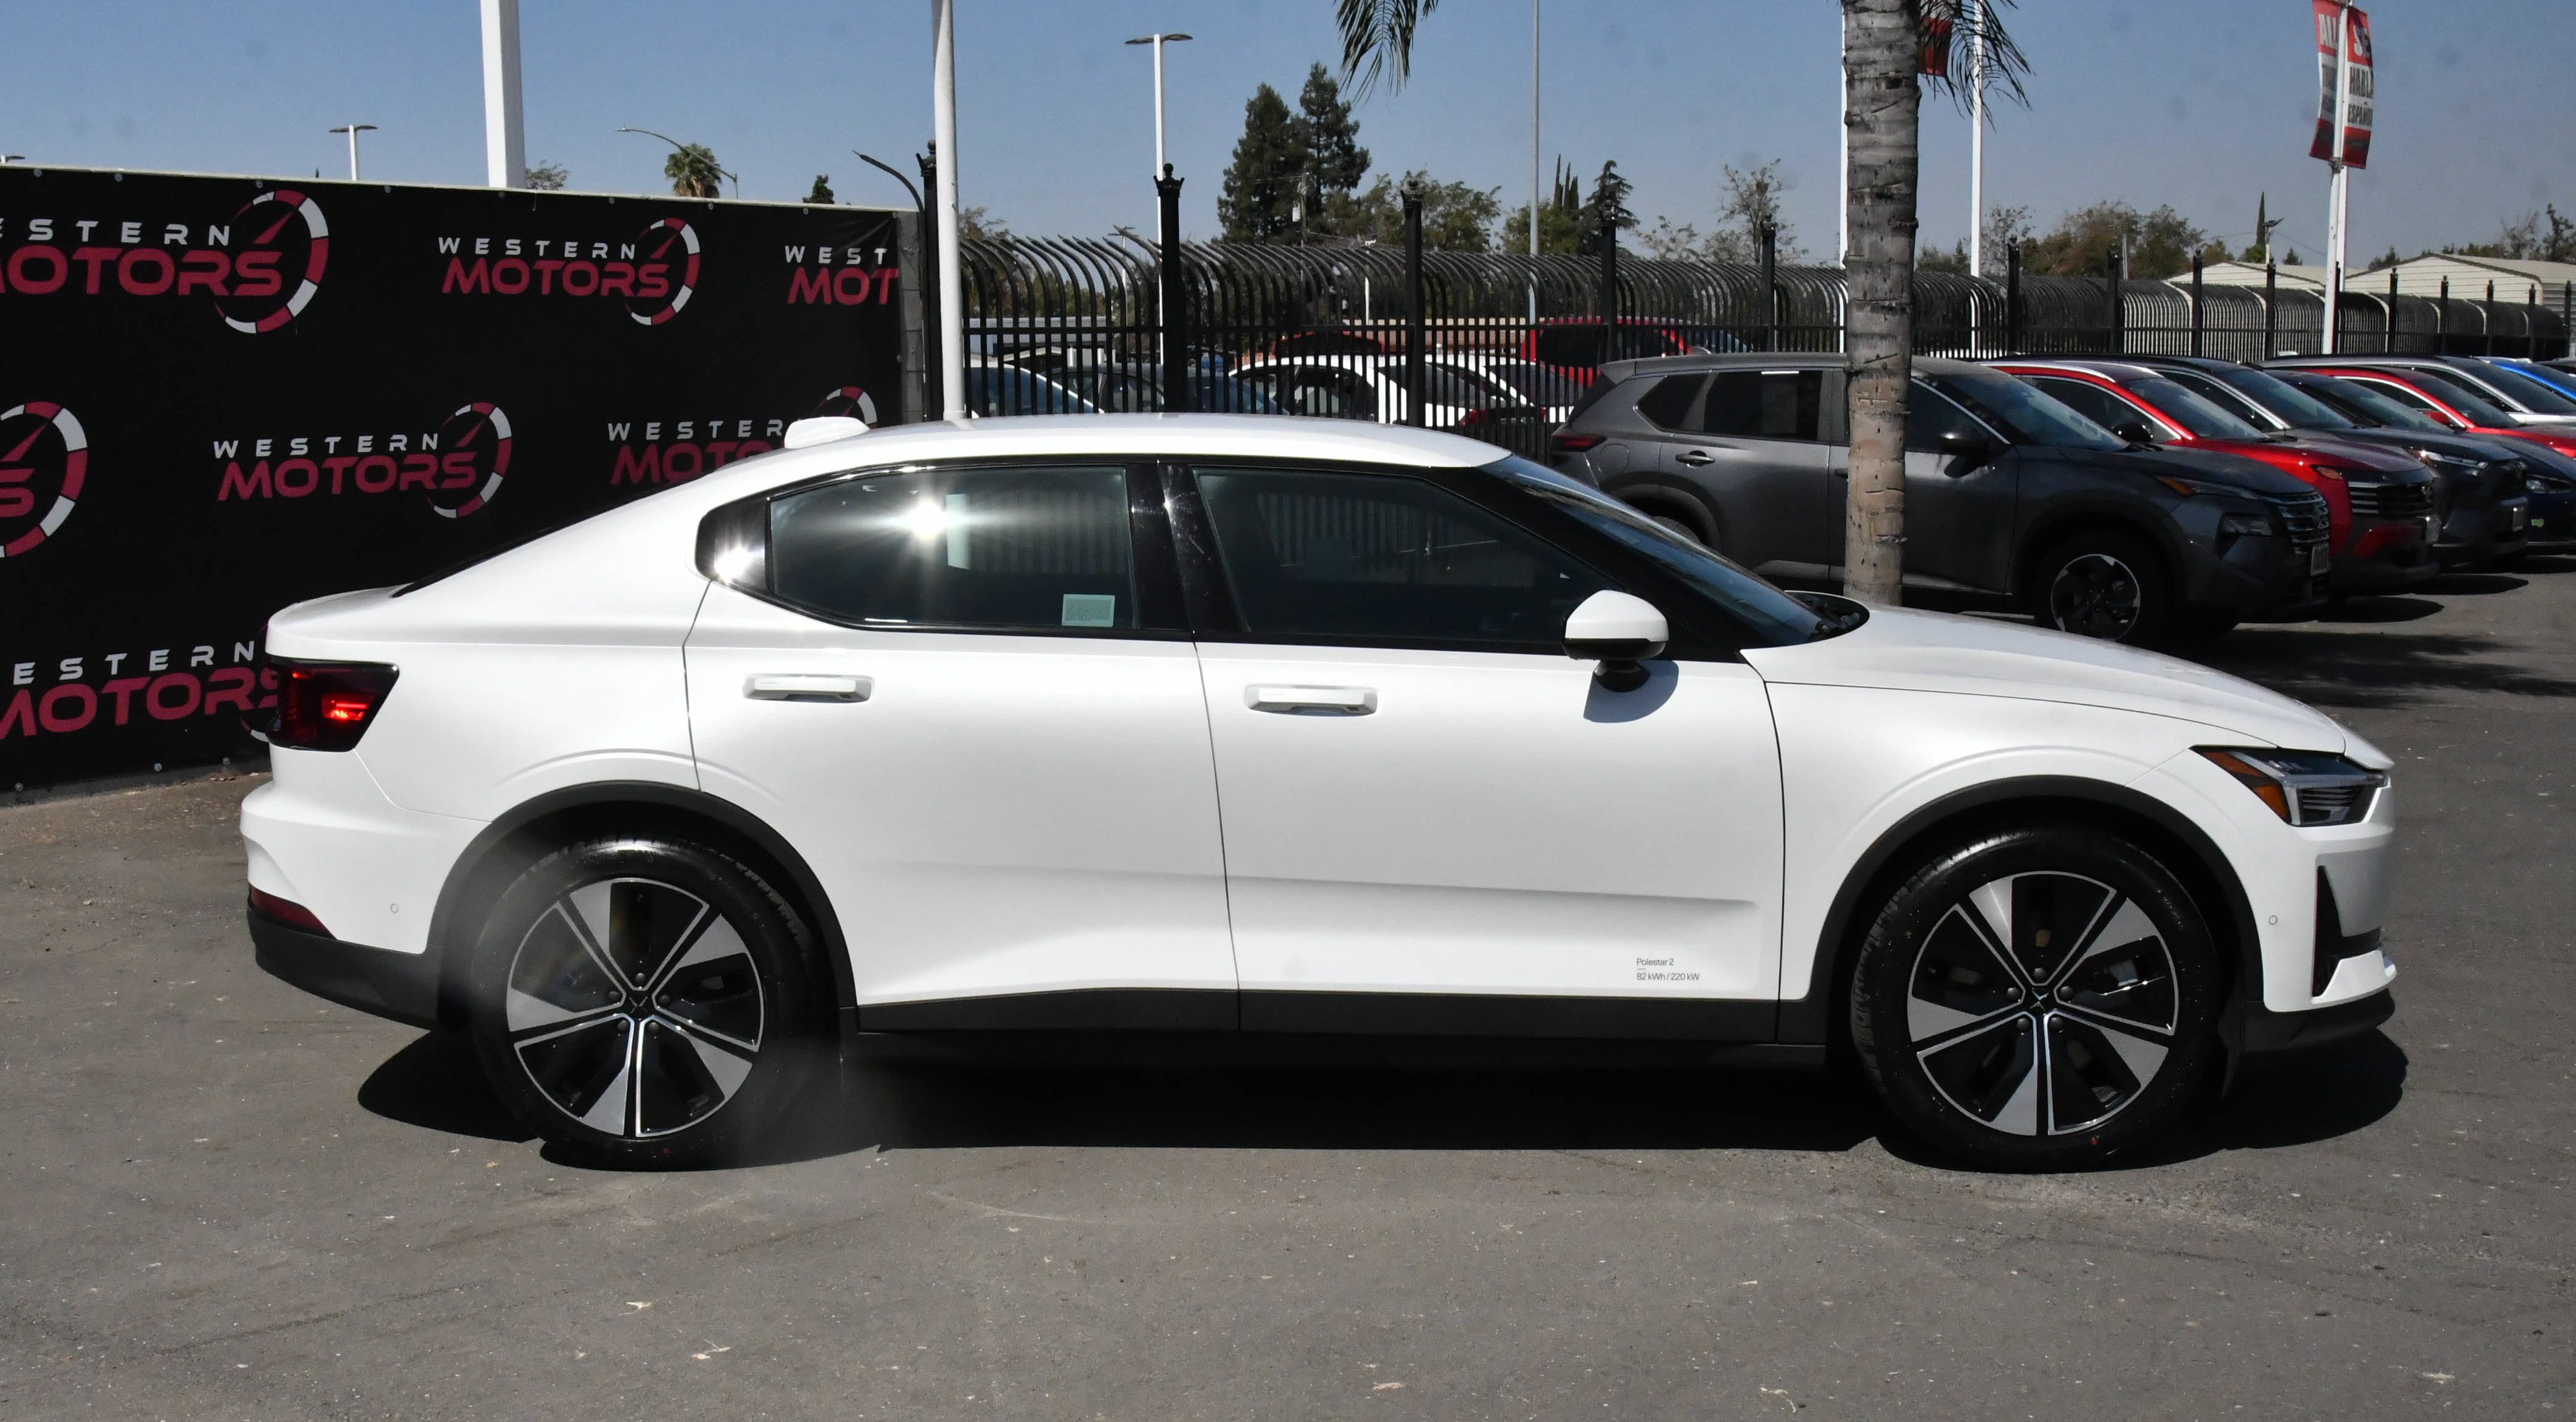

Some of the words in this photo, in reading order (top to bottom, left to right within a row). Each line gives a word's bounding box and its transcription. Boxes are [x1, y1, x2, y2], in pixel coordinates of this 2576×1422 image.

[2347, 101, 2373, 126] ESPAÑO
[0, 218, 230, 246] STERN
[438, 237, 635, 260] WESTERN
[785, 245, 888, 265] WEST
[0, 244, 283, 296] OTORS
[442, 257, 669, 297] MOTORS
[788, 267, 899, 305] MOT
[608, 419, 783, 441] WESTER
[213, 433, 439, 459] WESTERN
[611, 440, 773, 484] MOT
[217, 452, 477, 501] MOTORS
[1637, 957, 1668, 966] Polestar
[1669, 957, 1674, 966] 2
[1637, 972, 1646, 981] 82
[1648, 972, 1666, 981] kWh
[1670, 972, 1685, 981] 220
[1686, 972, 1700, 981] kW
